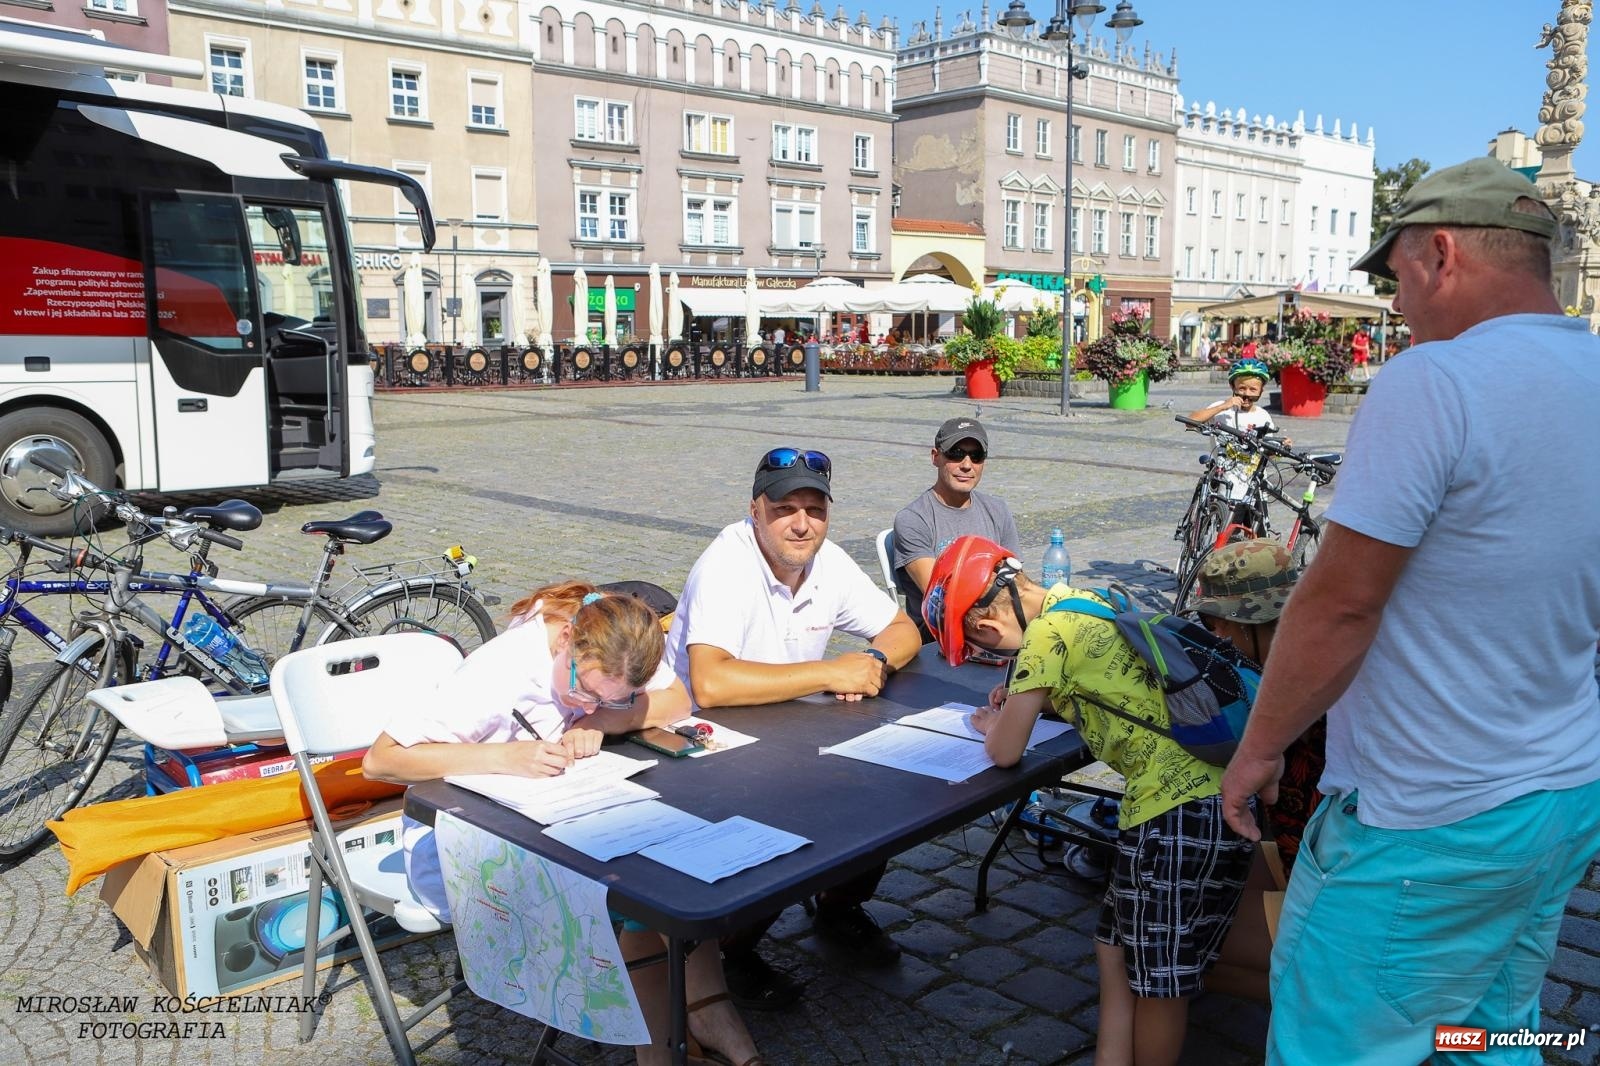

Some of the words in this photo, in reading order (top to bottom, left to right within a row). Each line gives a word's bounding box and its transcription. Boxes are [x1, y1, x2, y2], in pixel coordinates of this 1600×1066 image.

[32, 266, 60, 276] Zakup
[61, 268, 117, 278] sfinansowany
[35, 279, 77, 287] programu
[78, 279, 109, 288] polityki
[691, 275, 738, 288] Manufaktura
[23, 287, 81, 297] „Zapewnienie
[47, 299, 116, 309] Rzeczypospolitej
[23, 308, 46, 316] krew
[51, 309, 63, 318] jej
[63, 309, 101, 318] składniki
[263, 764, 284, 775] DEDRA
